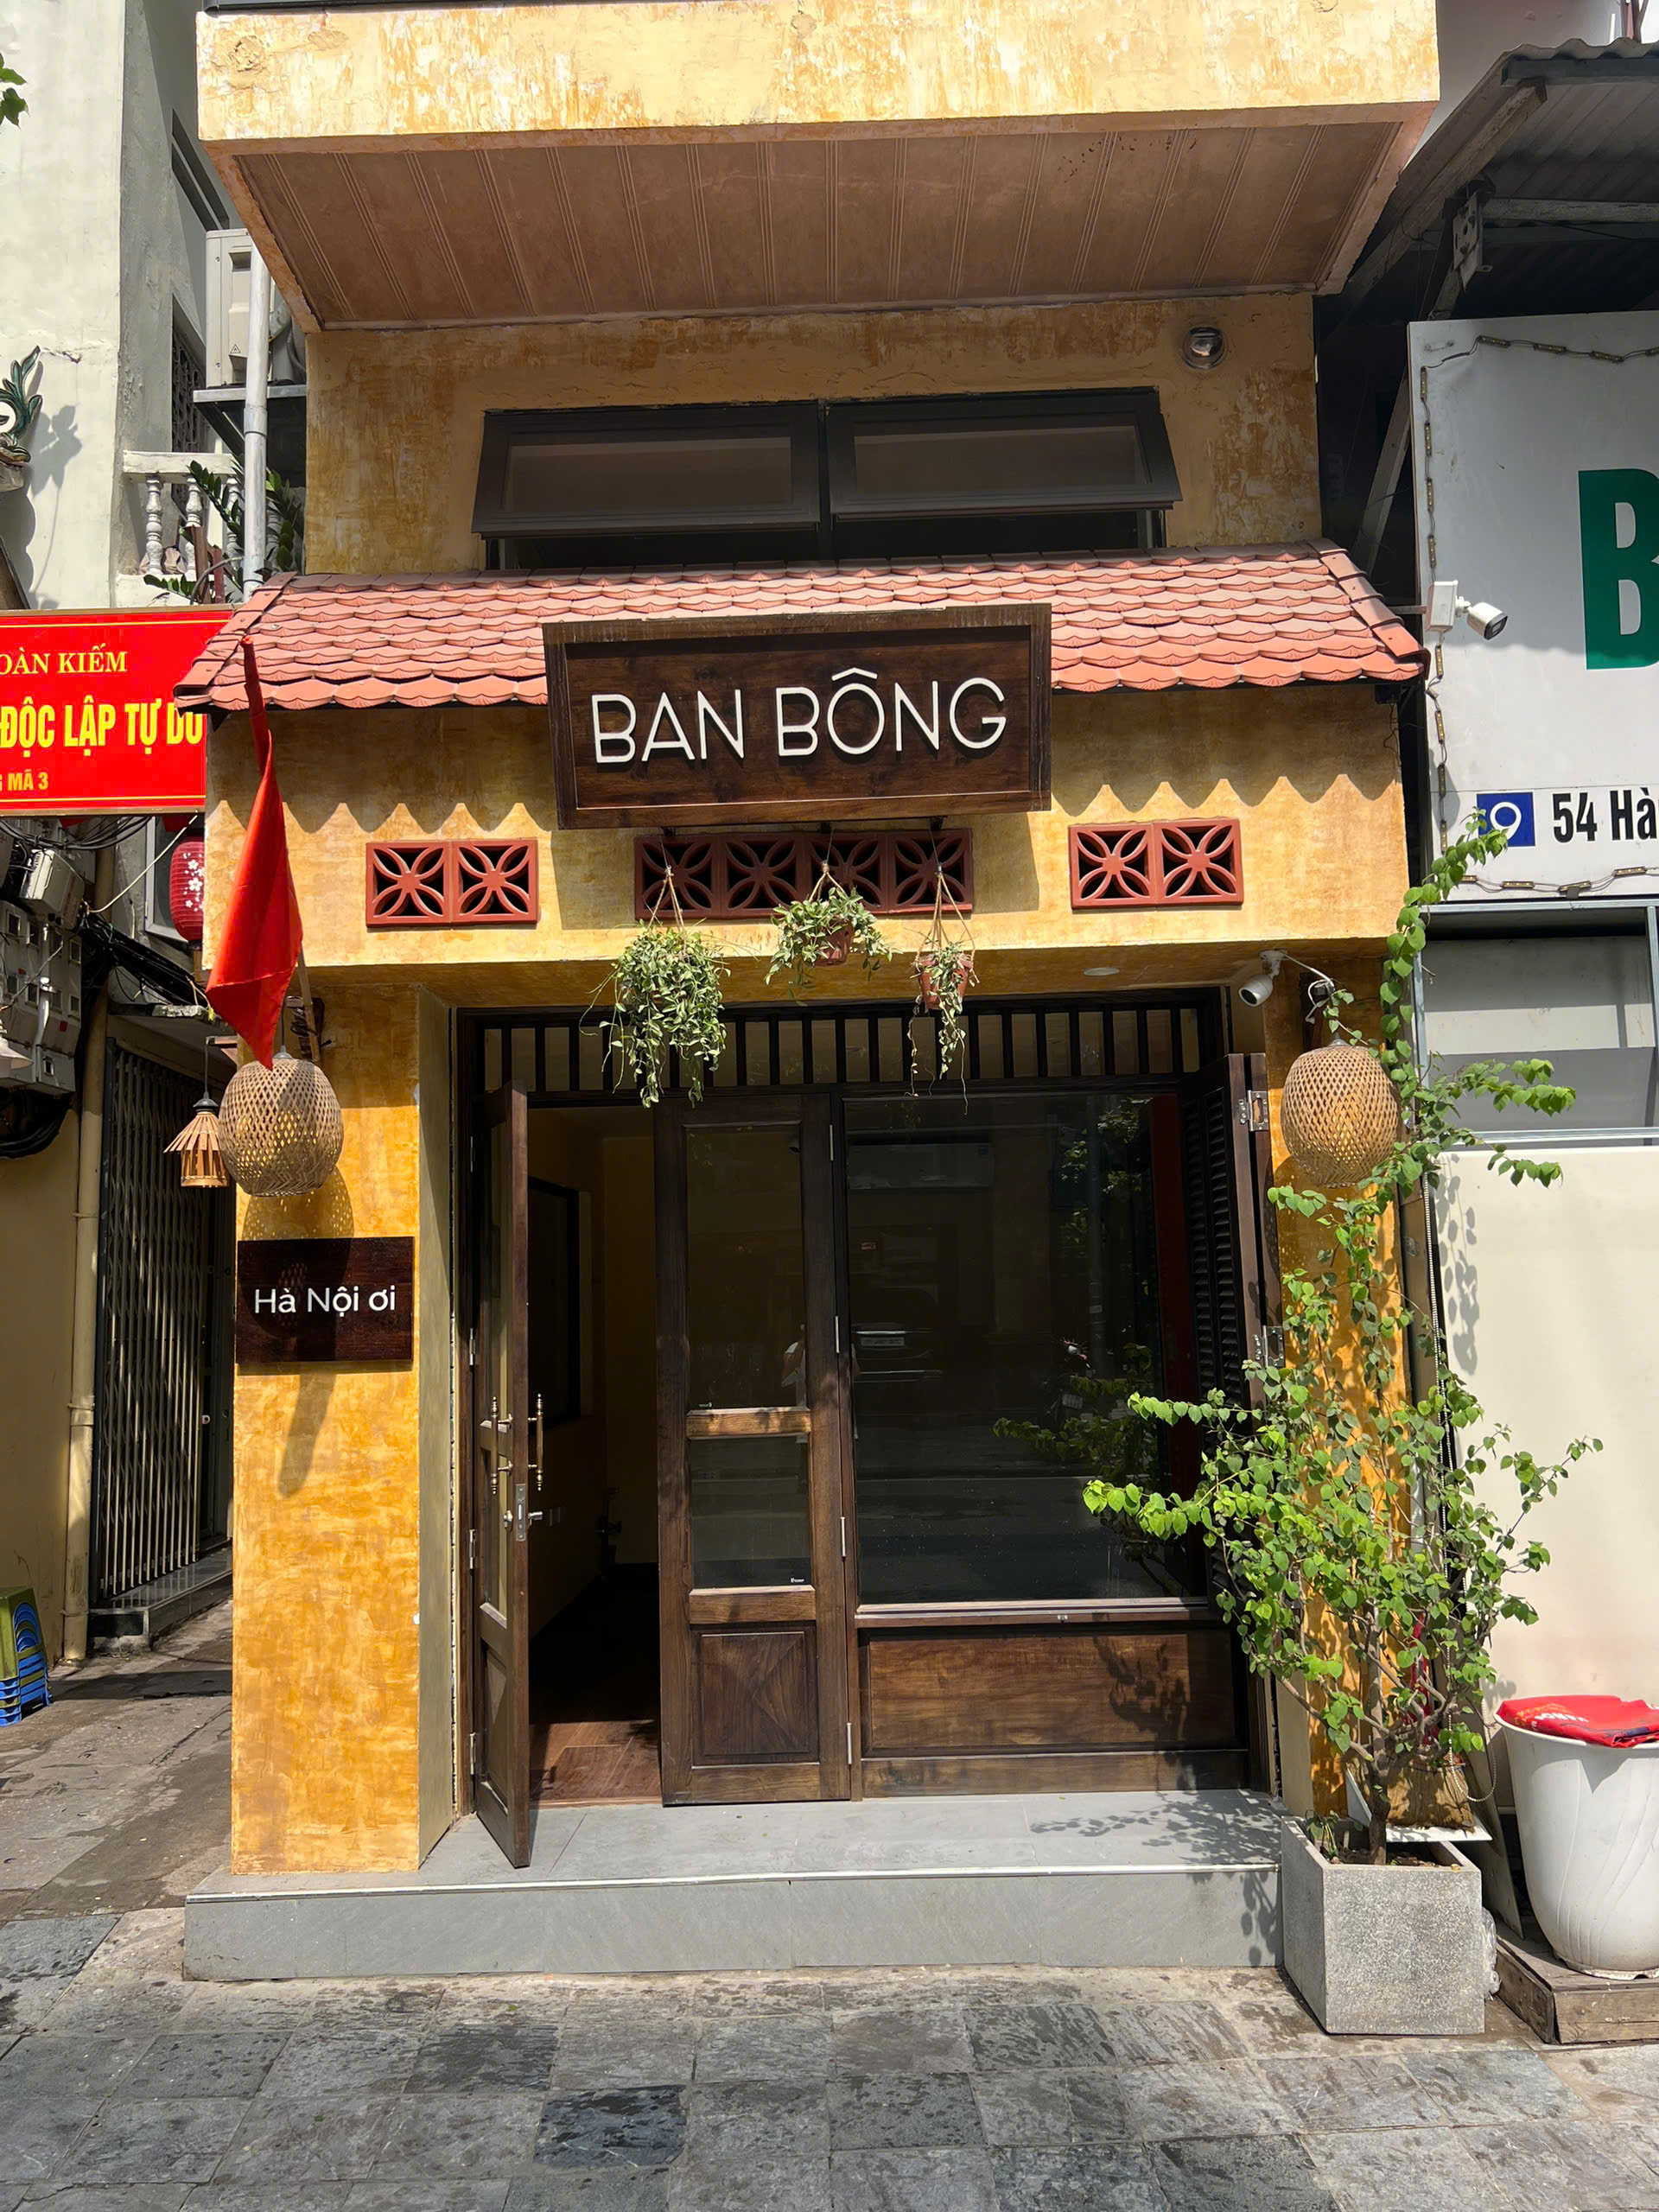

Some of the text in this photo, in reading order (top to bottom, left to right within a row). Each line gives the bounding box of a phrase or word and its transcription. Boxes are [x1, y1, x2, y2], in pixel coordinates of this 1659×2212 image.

[58, 643, 128, 674] KIẾM
[0, 696, 56, 758] ĐỘC
[64, 694, 117, 757] LẬP
[124, 697, 162, 755] TỰ
[592, 667, 1007, 763] BAN BÔNG
[8, 768, 35, 791] MÃ
[38, 772, 49, 791] 3
[1553, 791, 1598, 843] 54
[255, 1284, 396, 1318] Hà Nội ơi
